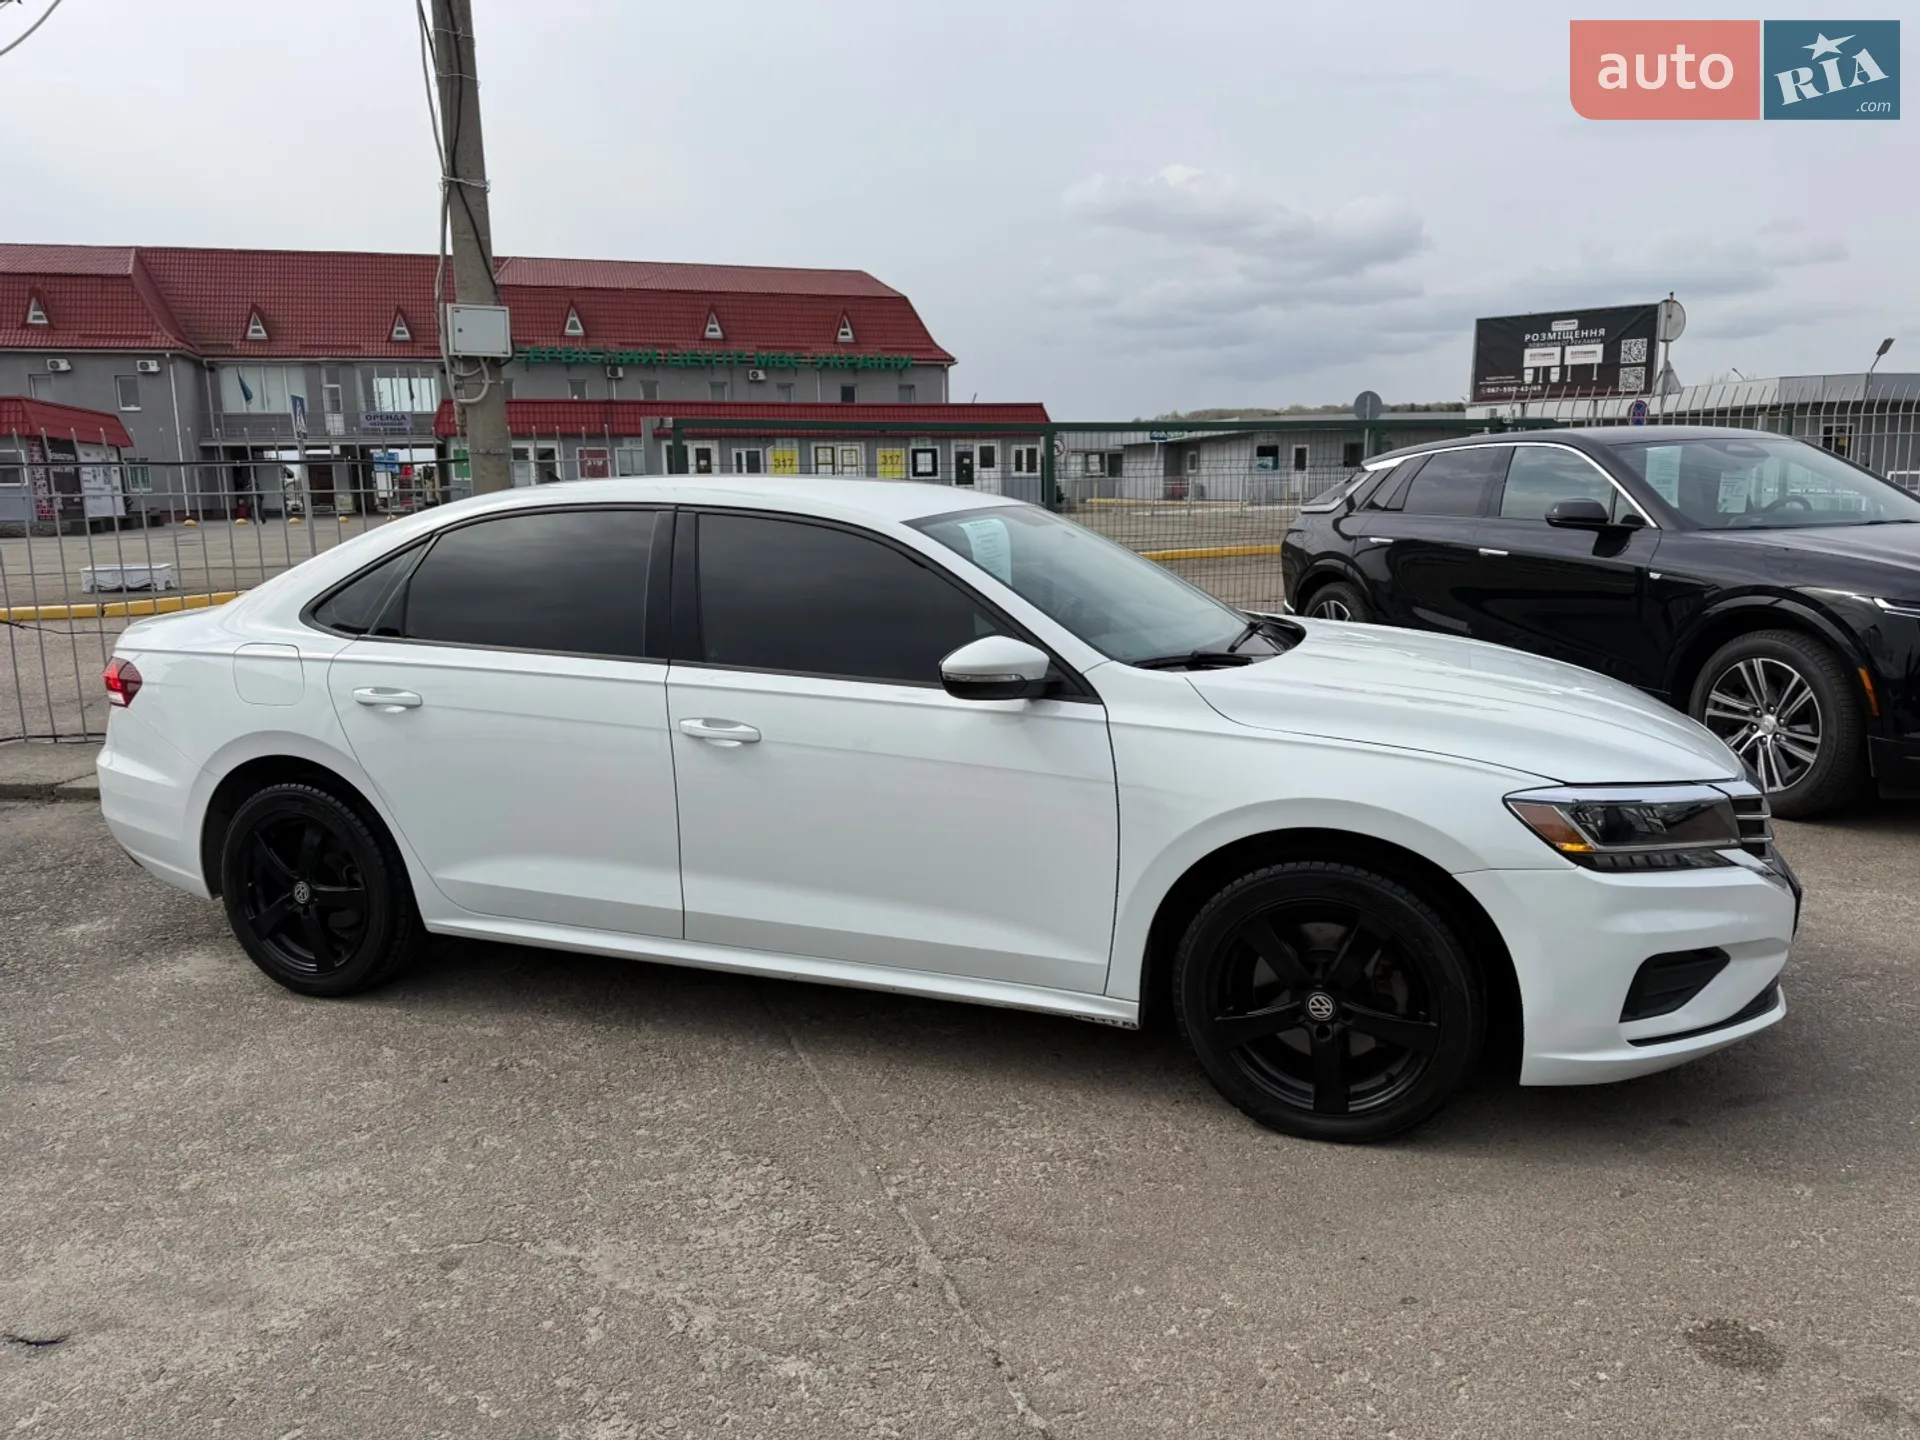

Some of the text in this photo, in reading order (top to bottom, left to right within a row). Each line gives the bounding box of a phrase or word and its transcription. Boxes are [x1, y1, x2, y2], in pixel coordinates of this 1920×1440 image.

[1524, 327, 1606, 342] РОЗМІЩЕННЯ
[667, 350, 746, 368] ЦЕНТР
[754, 351, 806, 368] МВС
[816, 351, 912, 369] УКРАЇНИ
[774, 458, 794, 469] 317
[881, 454, 901, 465] 317
